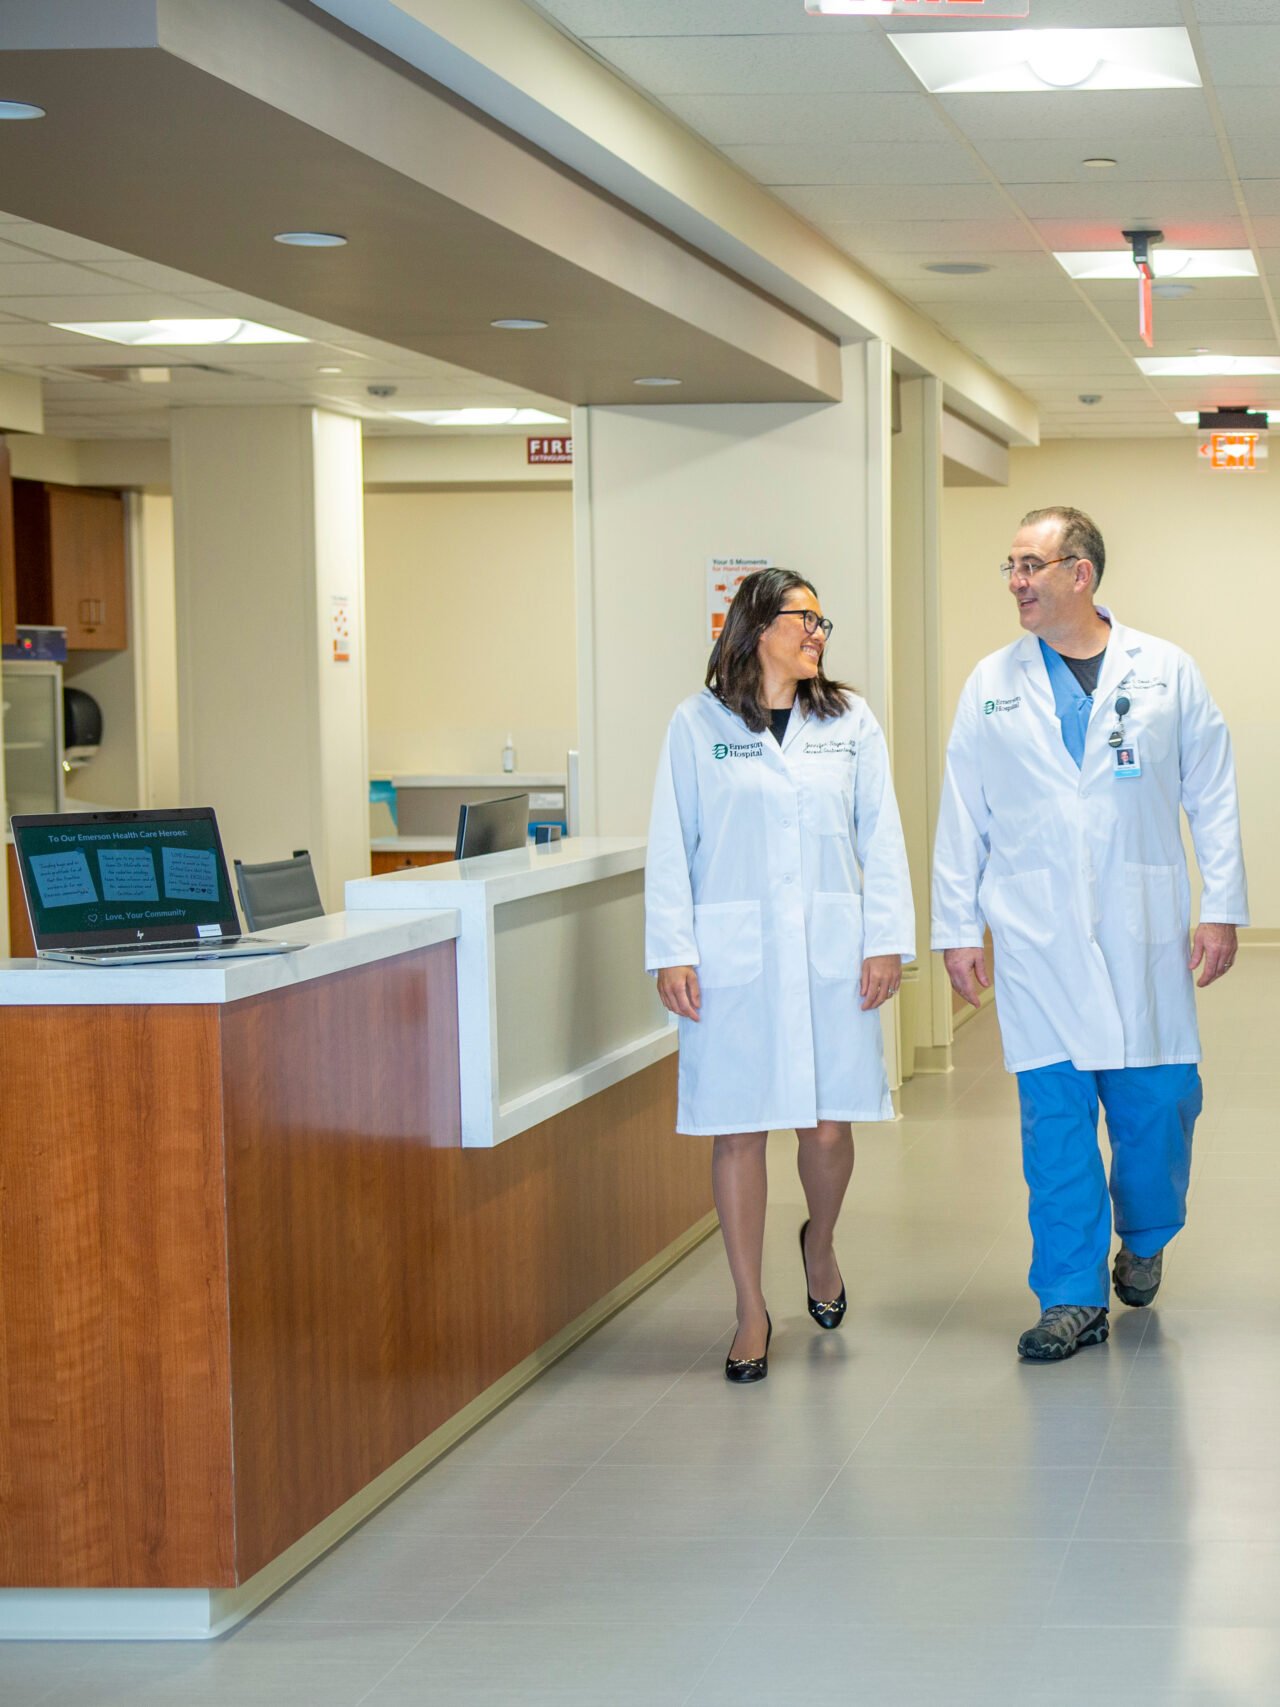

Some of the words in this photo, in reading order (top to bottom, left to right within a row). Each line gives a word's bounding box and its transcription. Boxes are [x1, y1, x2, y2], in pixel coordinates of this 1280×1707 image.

[530, 440, 573, 454] FIRE
[1211, 433, 1258, 469] EXIT
[729, 741, 763, 750] Emerson
[729, 748, 763, 759] Hospital
[48, 835, 59, 843] To
[60, 834, 76, 842] Our
[77, 832, 111, 841] Emerson
[112, 831, 138, 839] Health
[139, 830, 157, 838] Care
[158, 829, 188, 837] Heroes:
[144, 909, 187, 919] Community
